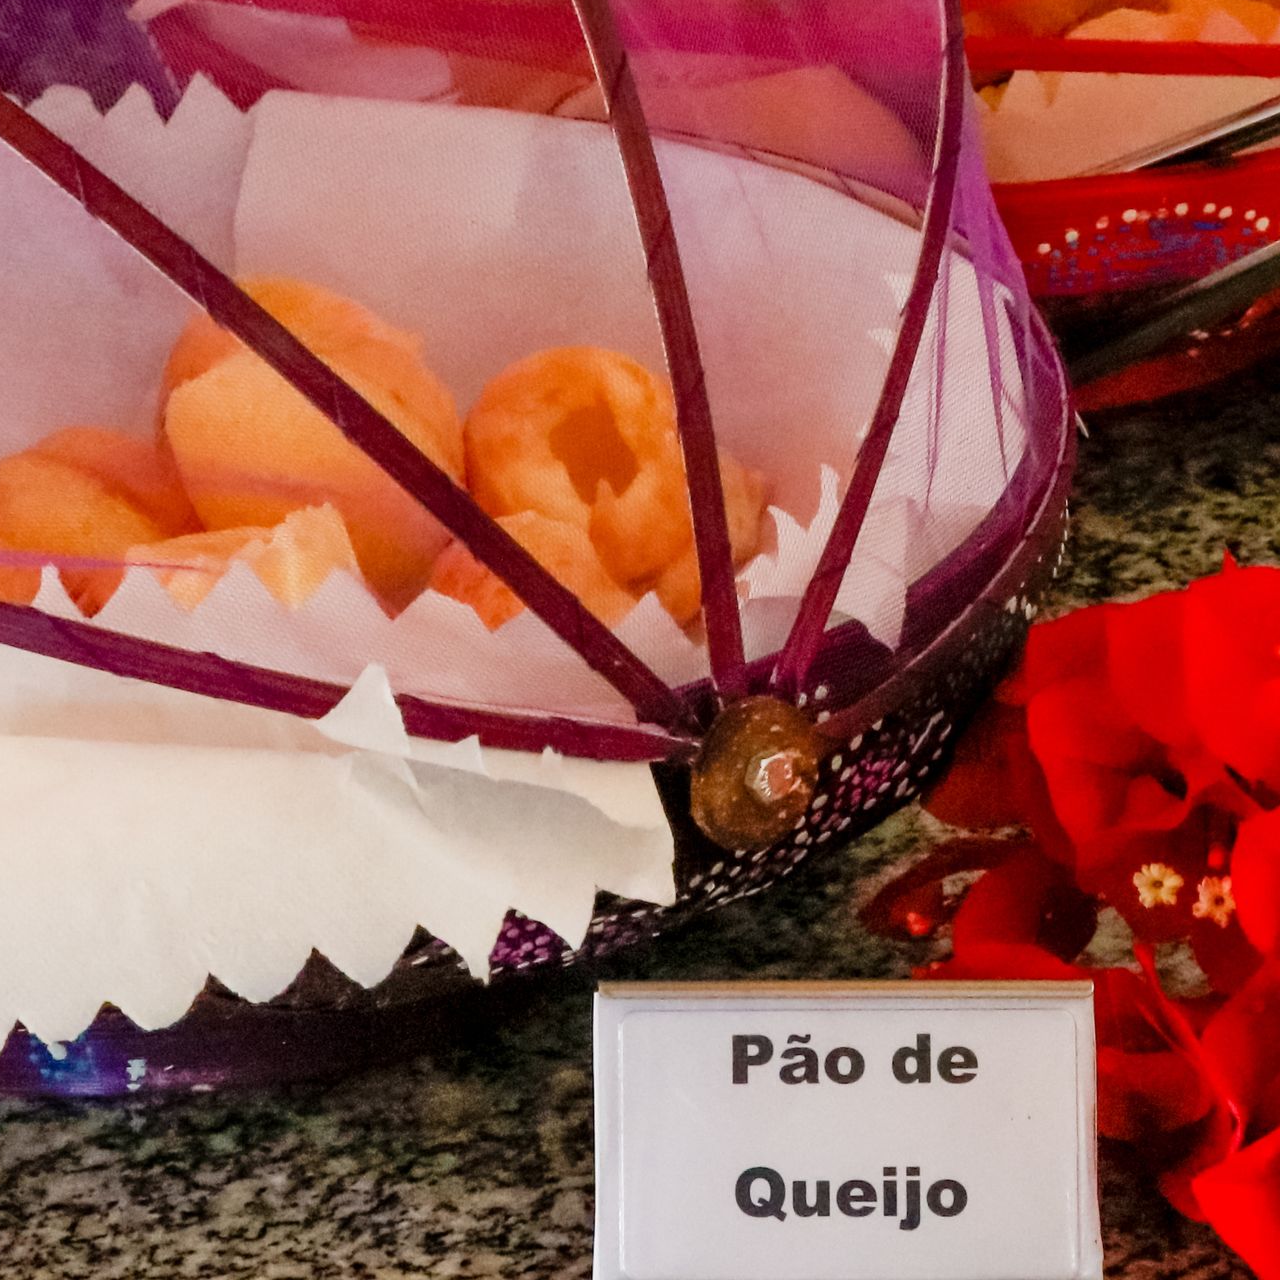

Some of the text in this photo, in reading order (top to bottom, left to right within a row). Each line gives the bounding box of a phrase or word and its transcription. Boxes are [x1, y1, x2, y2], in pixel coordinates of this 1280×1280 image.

[731, 1033, 979, 1086] Pão de
[734, 1166, 969, 1232] Queijo
